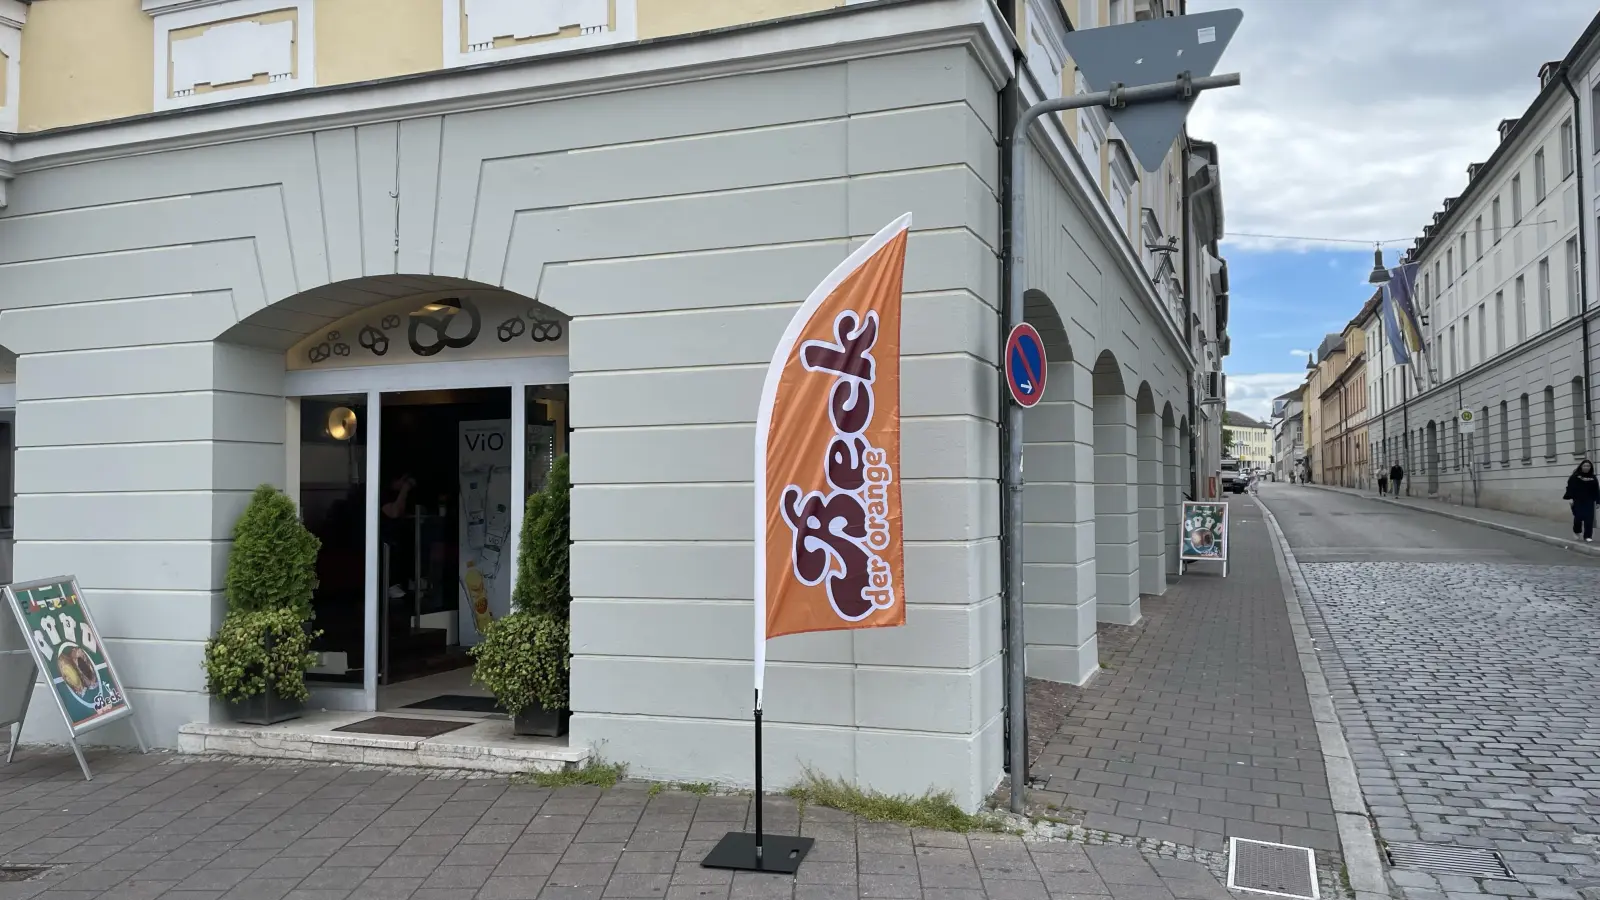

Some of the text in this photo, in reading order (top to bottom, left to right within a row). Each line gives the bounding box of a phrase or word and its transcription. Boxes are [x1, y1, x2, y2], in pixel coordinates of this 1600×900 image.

[465, 432, 504, 451] ViO
[781, 311, 879, 620] Beck
[863, 449, 894, 609] der orange
[94, 688, 122, 711] Beck
